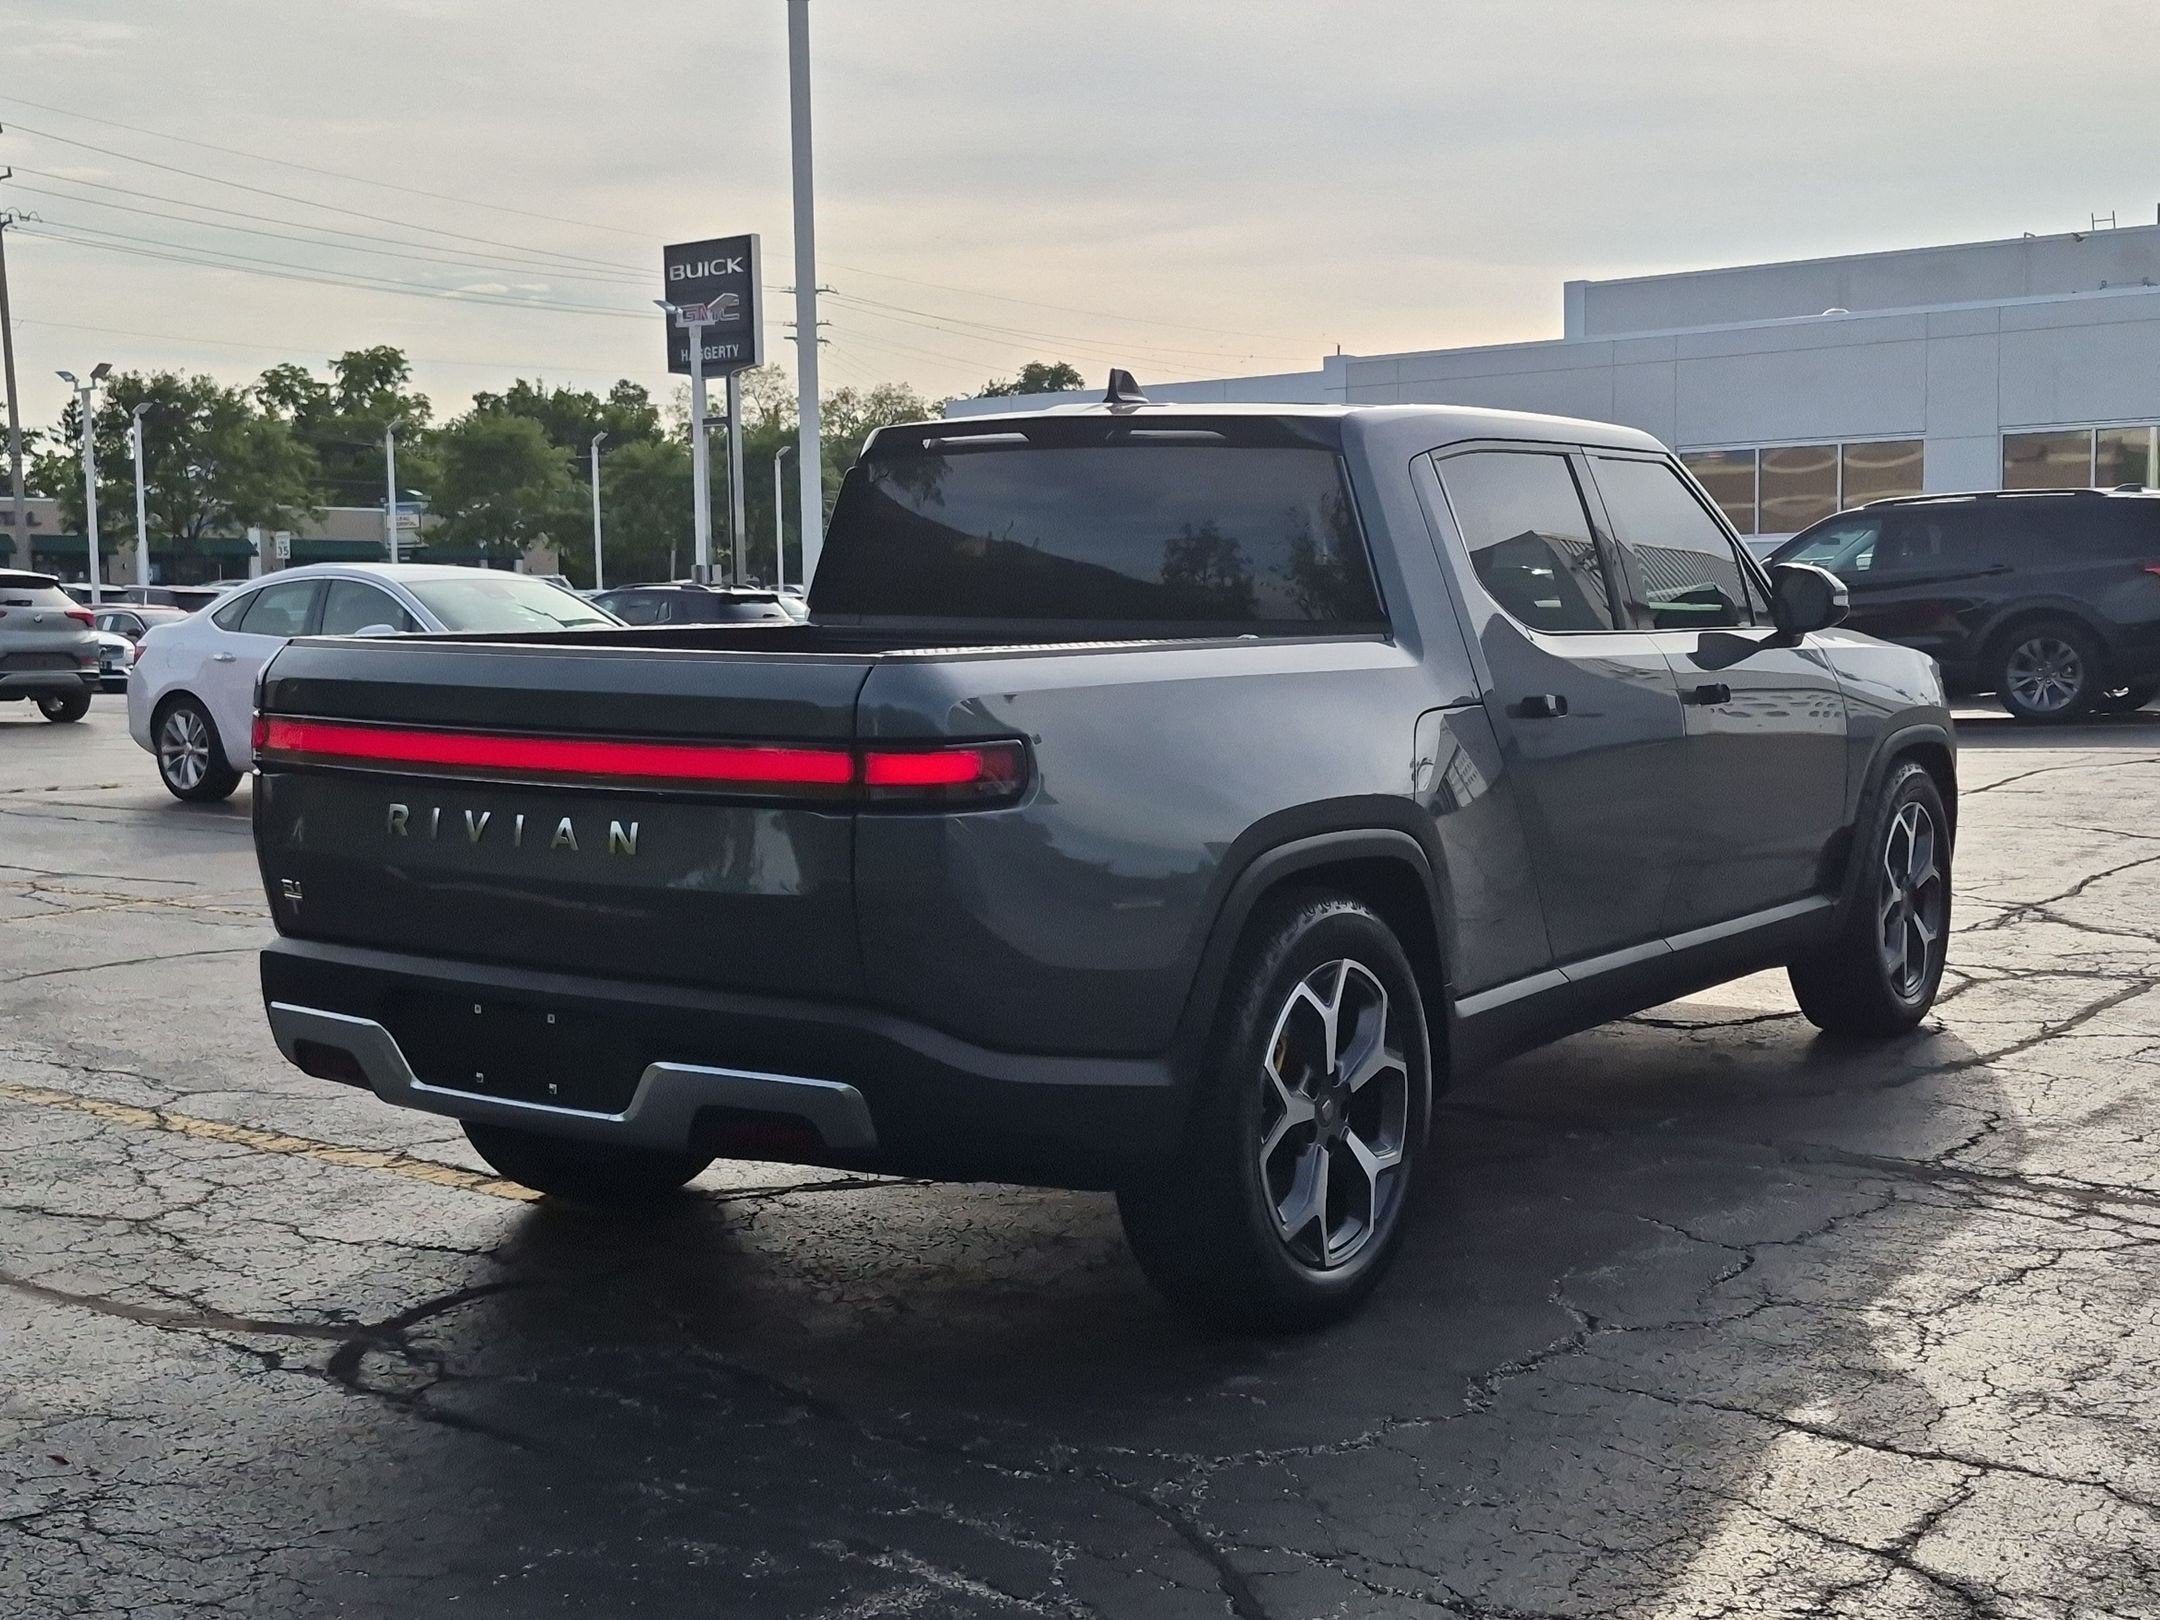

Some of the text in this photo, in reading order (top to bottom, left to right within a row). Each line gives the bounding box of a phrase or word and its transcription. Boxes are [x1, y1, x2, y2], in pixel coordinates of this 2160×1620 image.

[669, 256, 744, 281] BUICK
[681, 344, 739, 362] HGERTY
[388, 803, 639, 856] RIVIAN
